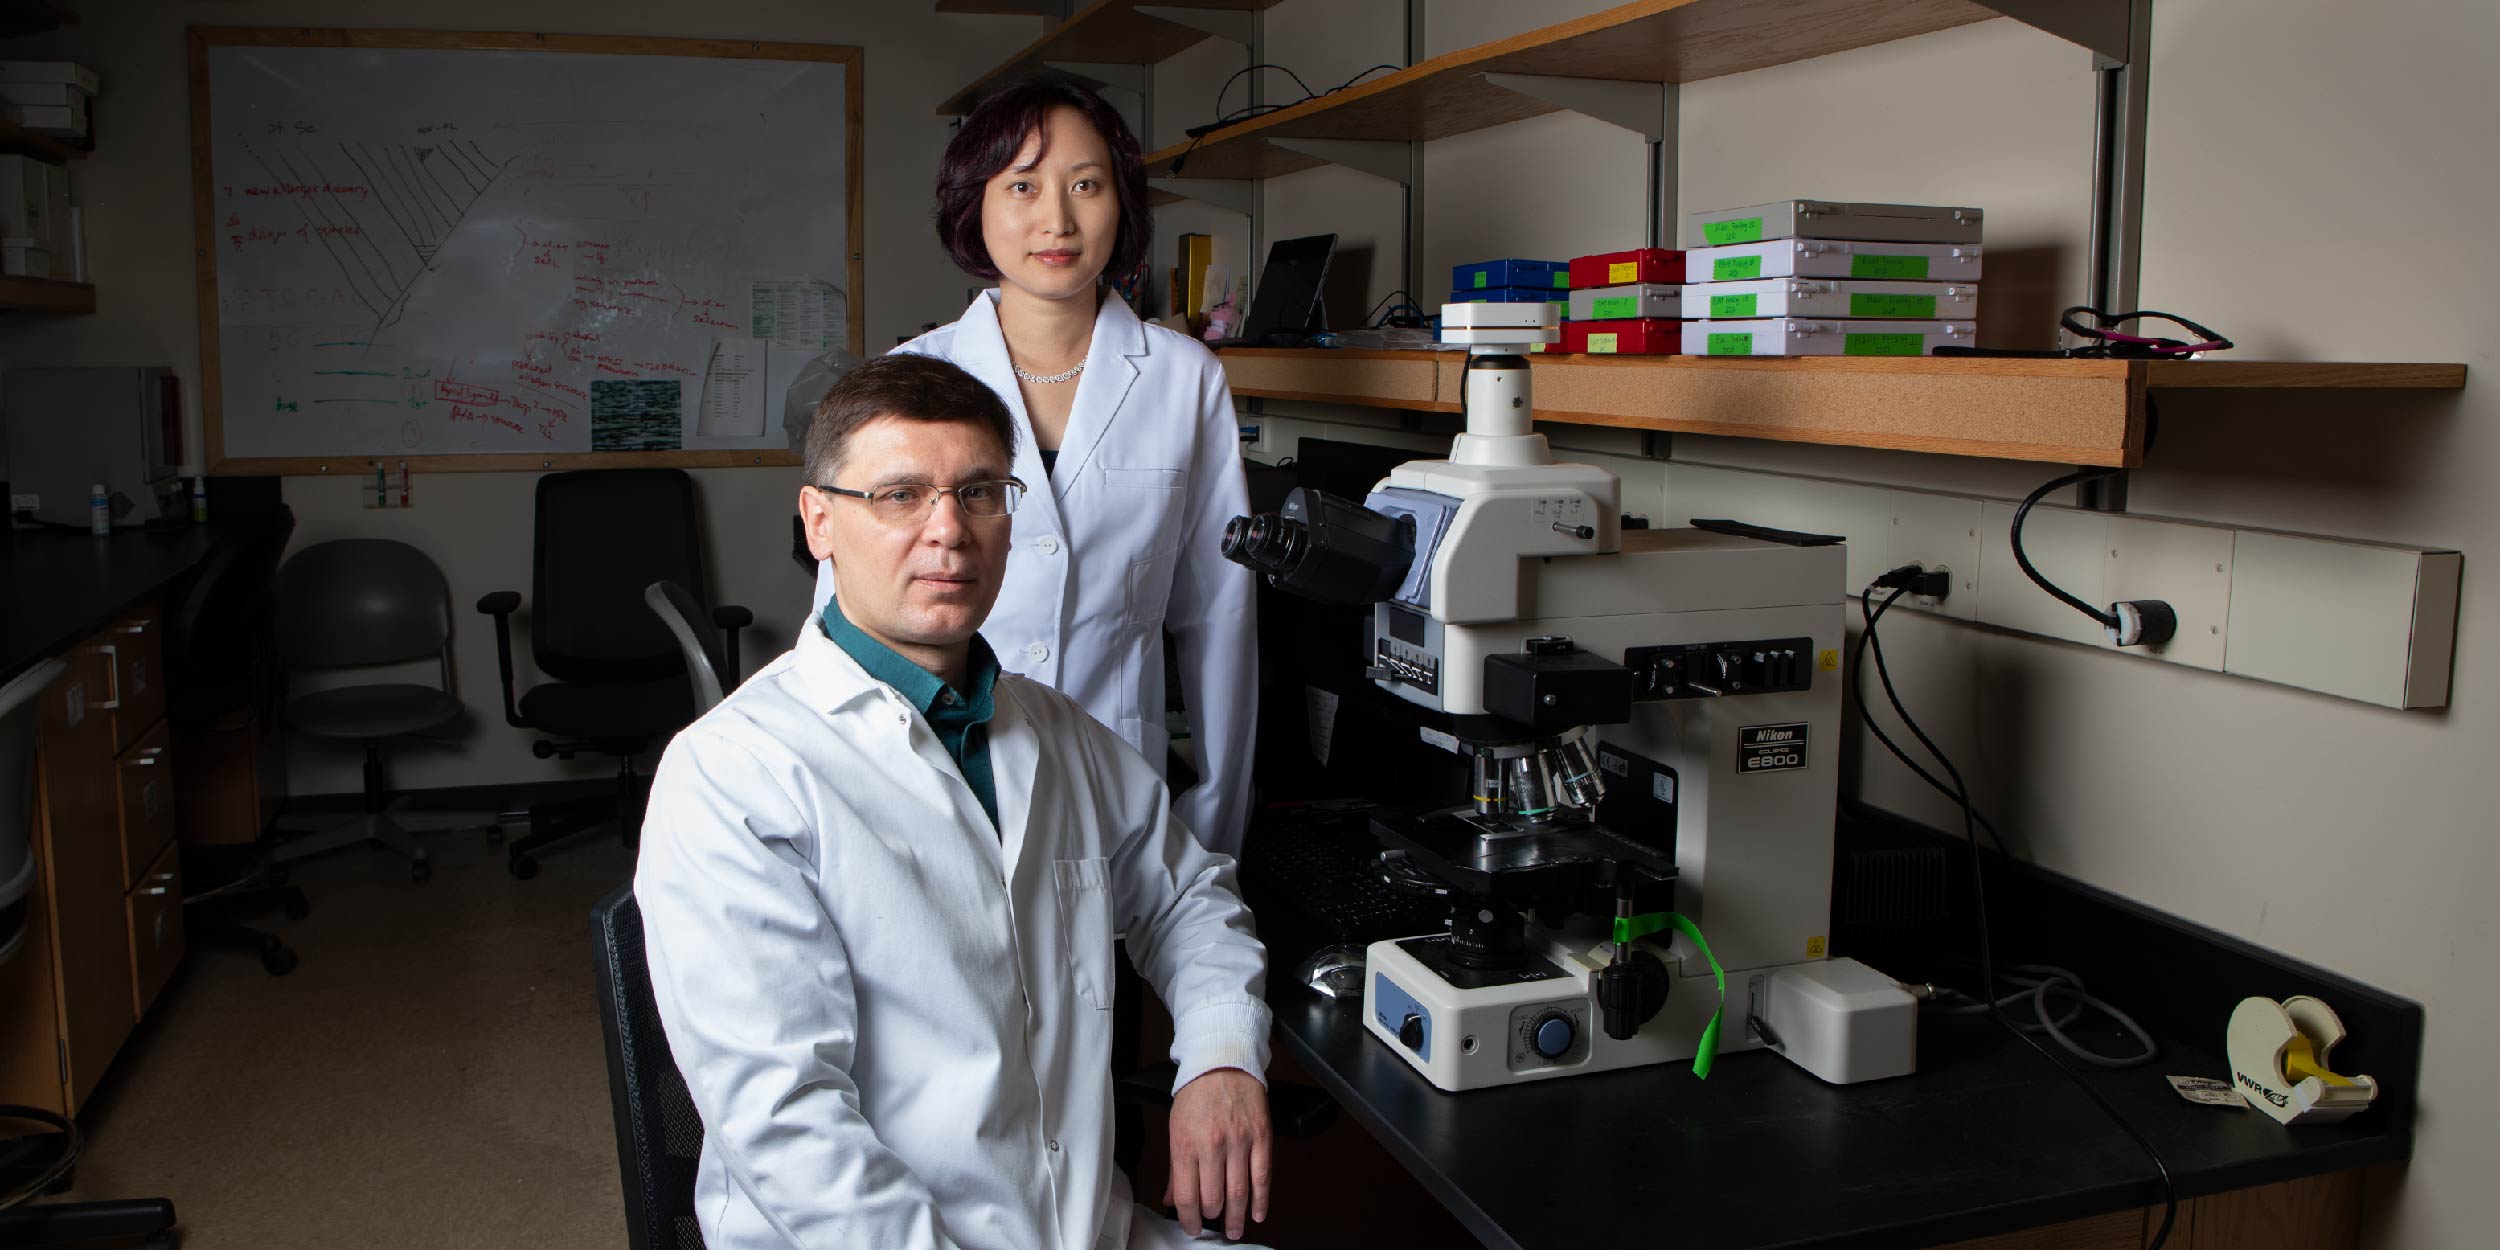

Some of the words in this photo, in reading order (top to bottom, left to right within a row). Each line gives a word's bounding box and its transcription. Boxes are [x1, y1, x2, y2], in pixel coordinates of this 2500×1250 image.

[1756, 729, 1794, 742] Nikon
[1747, 754, 1799, 768] E800
[2236, 1071, 2263, 1094] VWR
